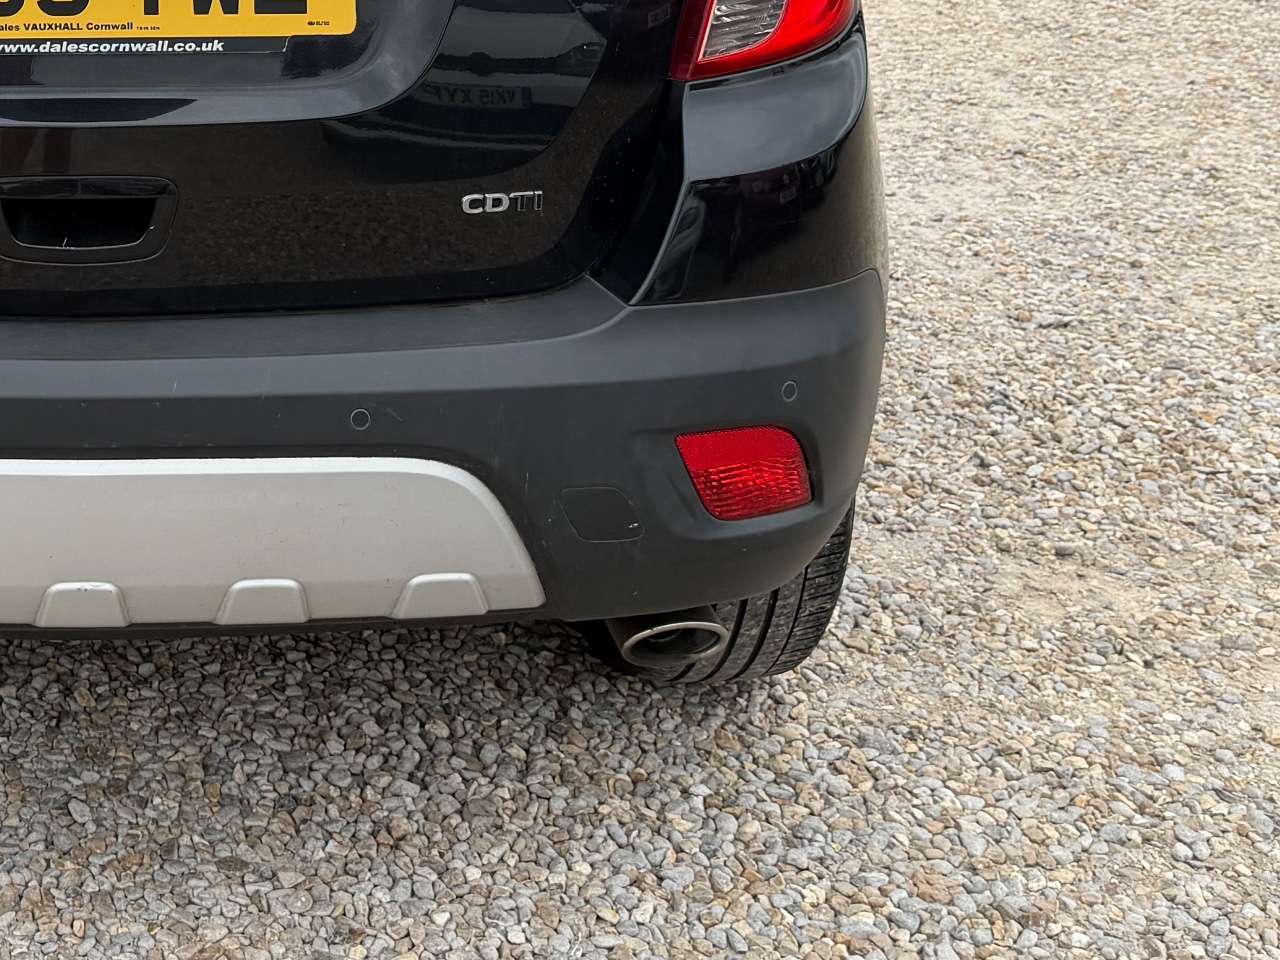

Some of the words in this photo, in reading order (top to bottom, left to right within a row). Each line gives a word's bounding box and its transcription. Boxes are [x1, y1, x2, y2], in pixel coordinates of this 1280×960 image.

[23, 23, 83, 32] VAUXHALL
[86, 22, 133, 31] Cornwall
[461, 191, 543, 214] CDTI
